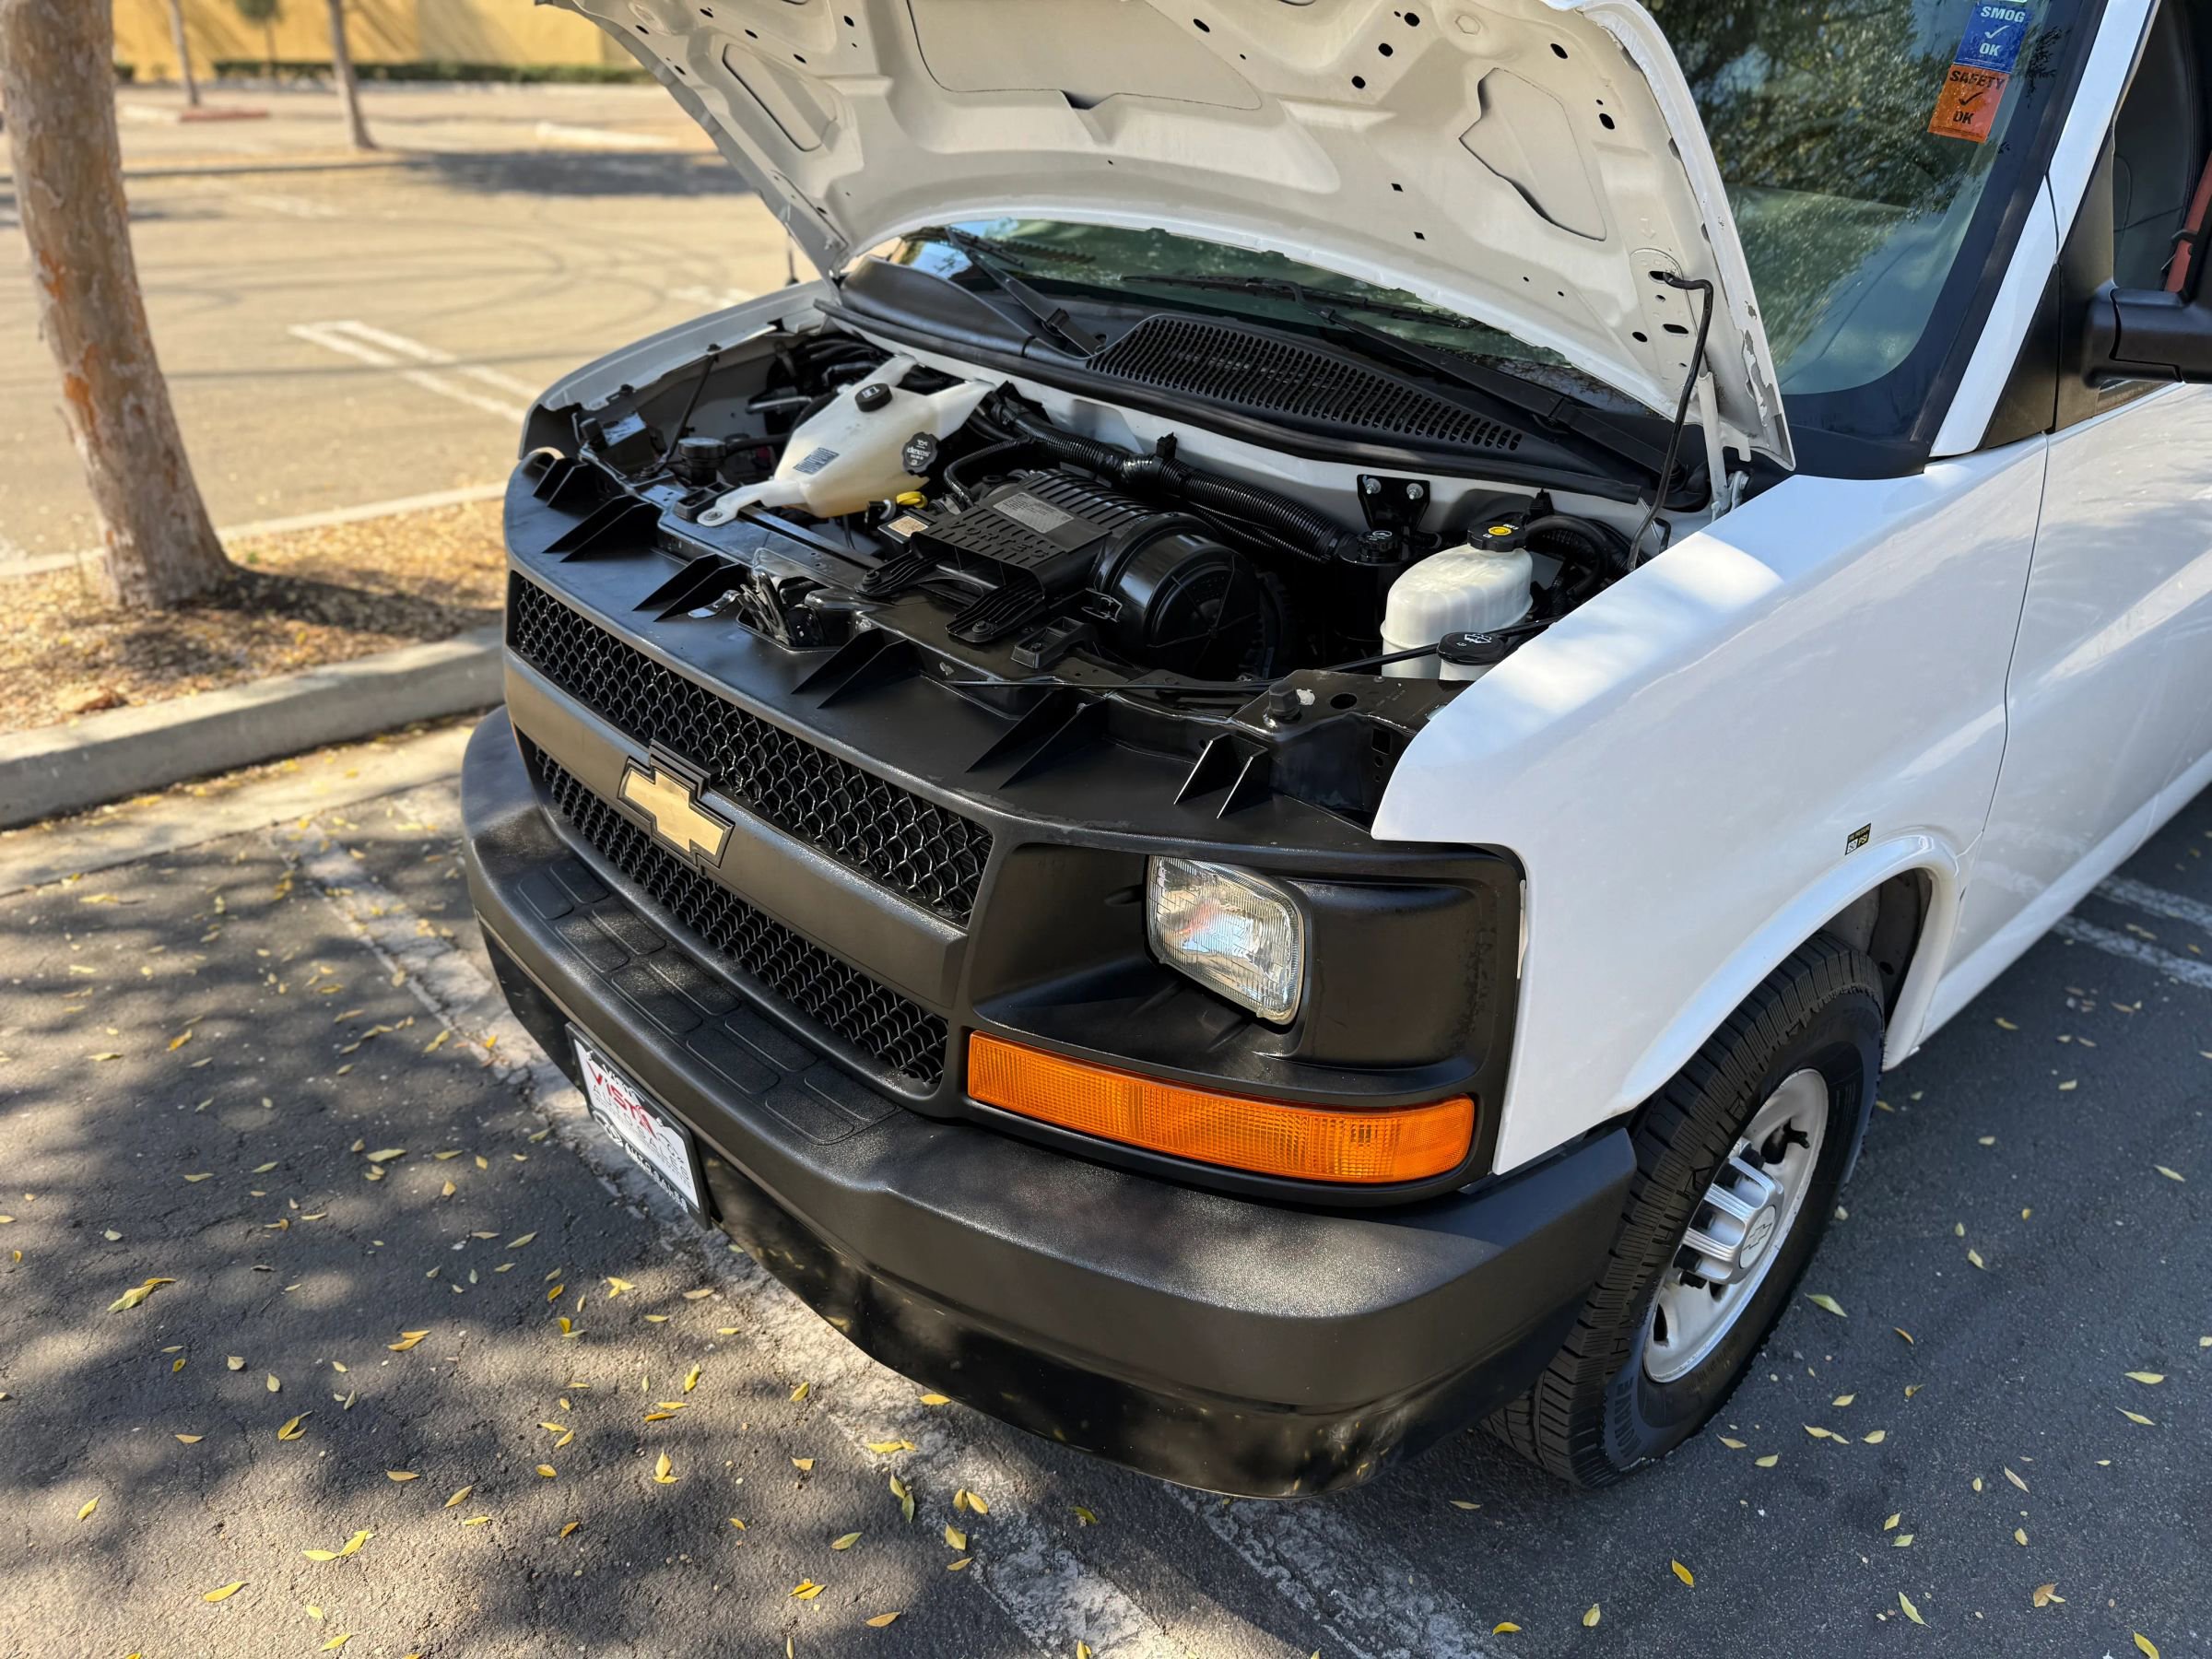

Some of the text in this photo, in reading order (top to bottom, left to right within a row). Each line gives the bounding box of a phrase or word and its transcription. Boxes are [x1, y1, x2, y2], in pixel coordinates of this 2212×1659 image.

[1981, 6, 2026, 23] SMOG
[1979, 42, 2001, 56] OK
[1949, 70, 2006, 89] SAFETY
[1952, 111, 1974, 124] OK
[948, 521, 1051, 559] VORTEC
[586, 1060, 658, 1140] VISTA
